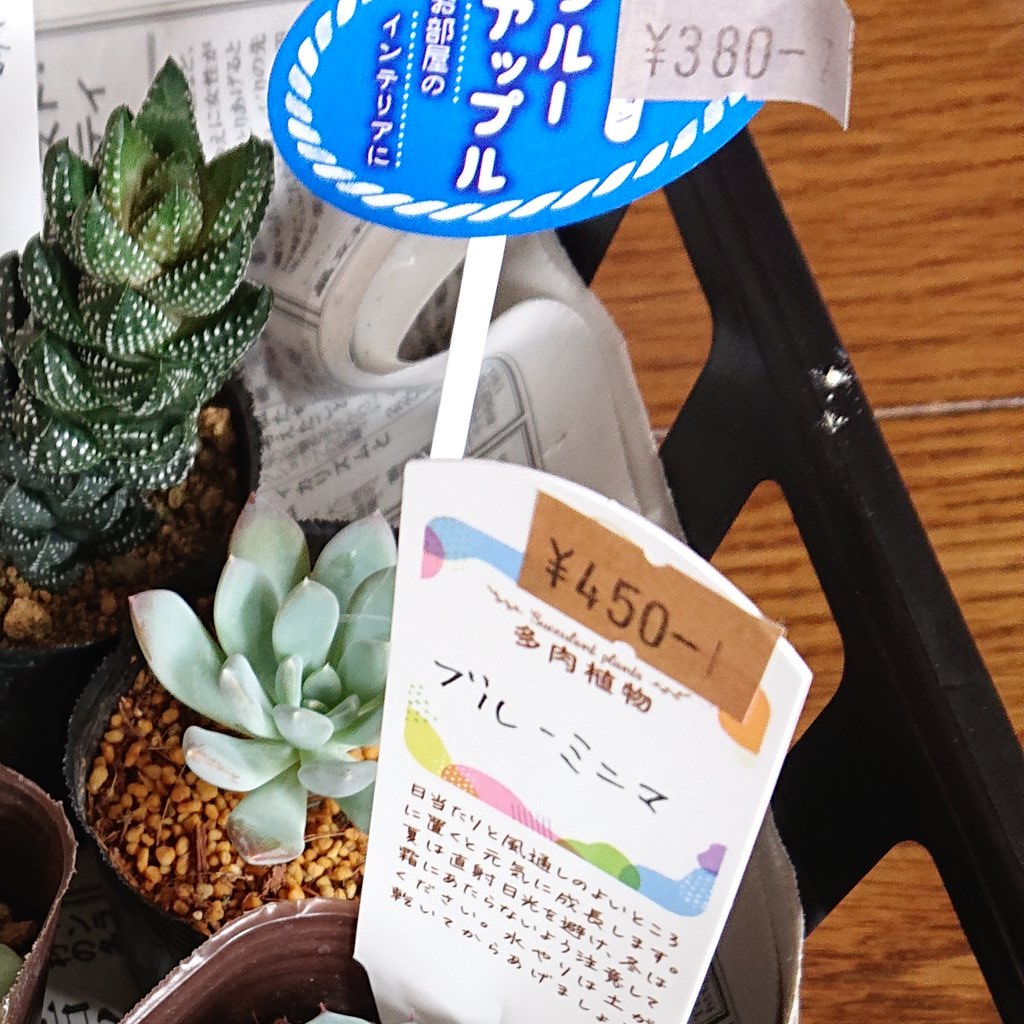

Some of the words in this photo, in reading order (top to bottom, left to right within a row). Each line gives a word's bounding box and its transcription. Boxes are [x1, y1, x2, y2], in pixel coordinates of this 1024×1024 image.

[367, 13, 402, 166] インテリアに
[539, 0, 593, 125] ルー
[434, 659, 669, 814] ブルーミニマ
[514, 624, 653, 714] 多肉植物
